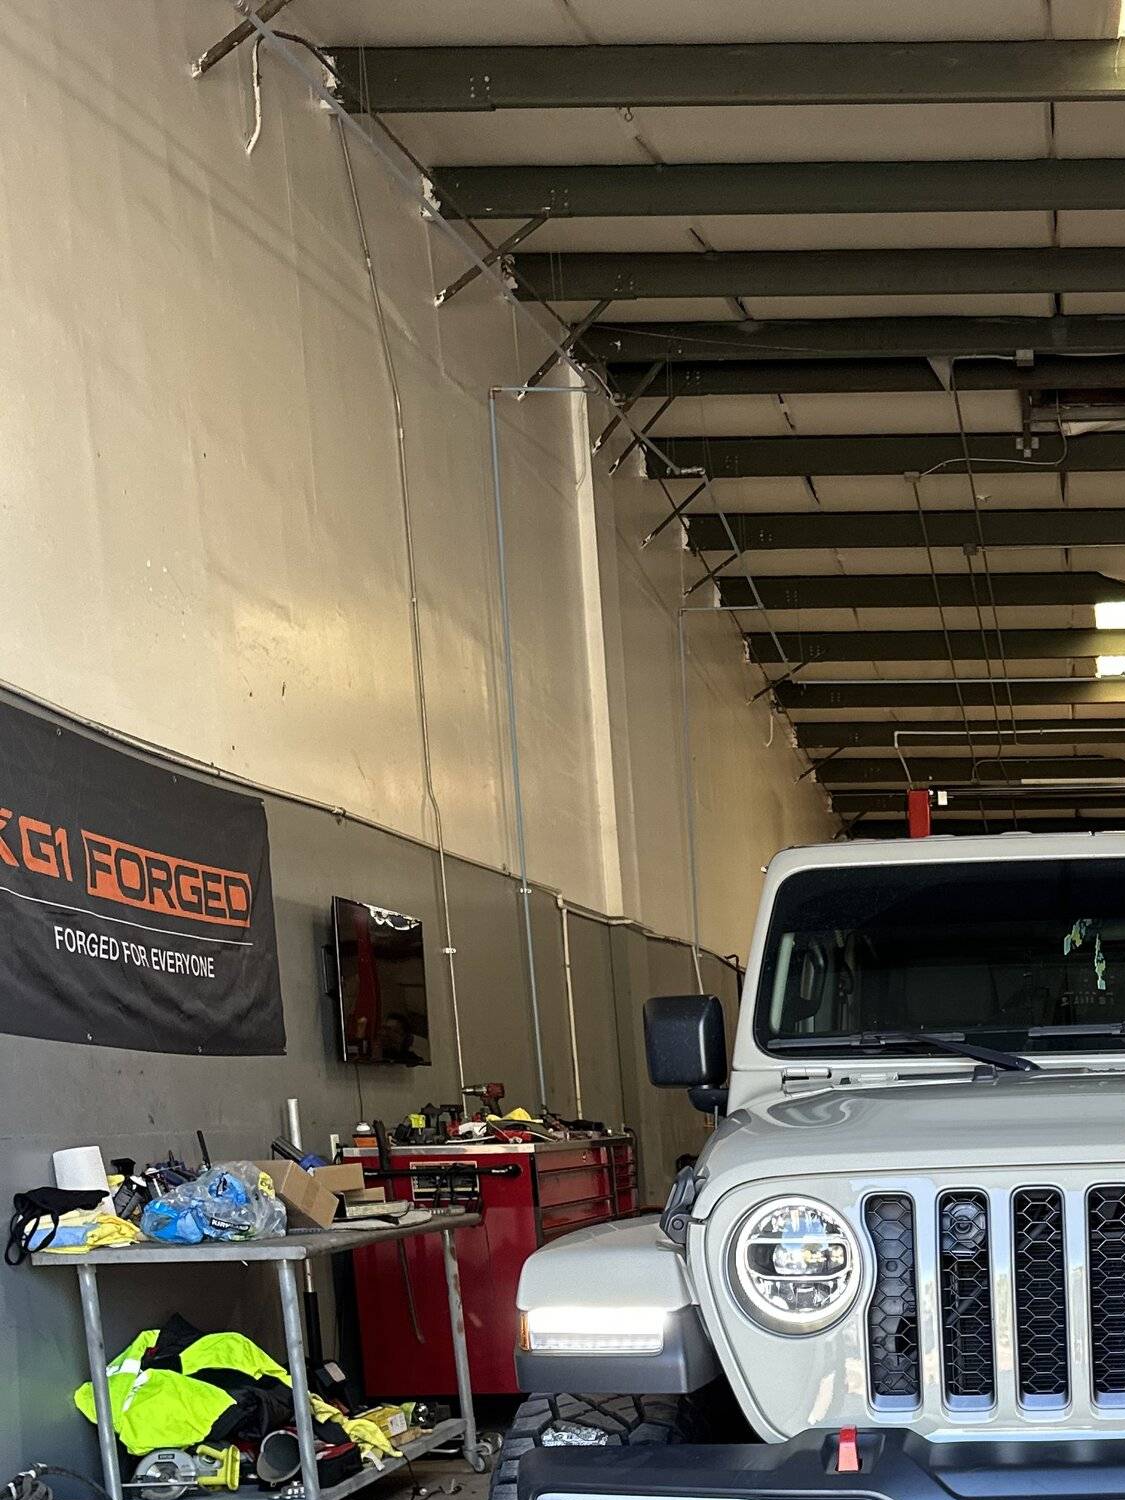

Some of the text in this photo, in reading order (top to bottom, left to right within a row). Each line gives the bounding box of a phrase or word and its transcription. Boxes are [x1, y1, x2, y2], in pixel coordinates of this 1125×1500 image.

[83, 832, 252, 924] FORGED
[54, 926, 215, 978] FORGED FOR EVERYONE
